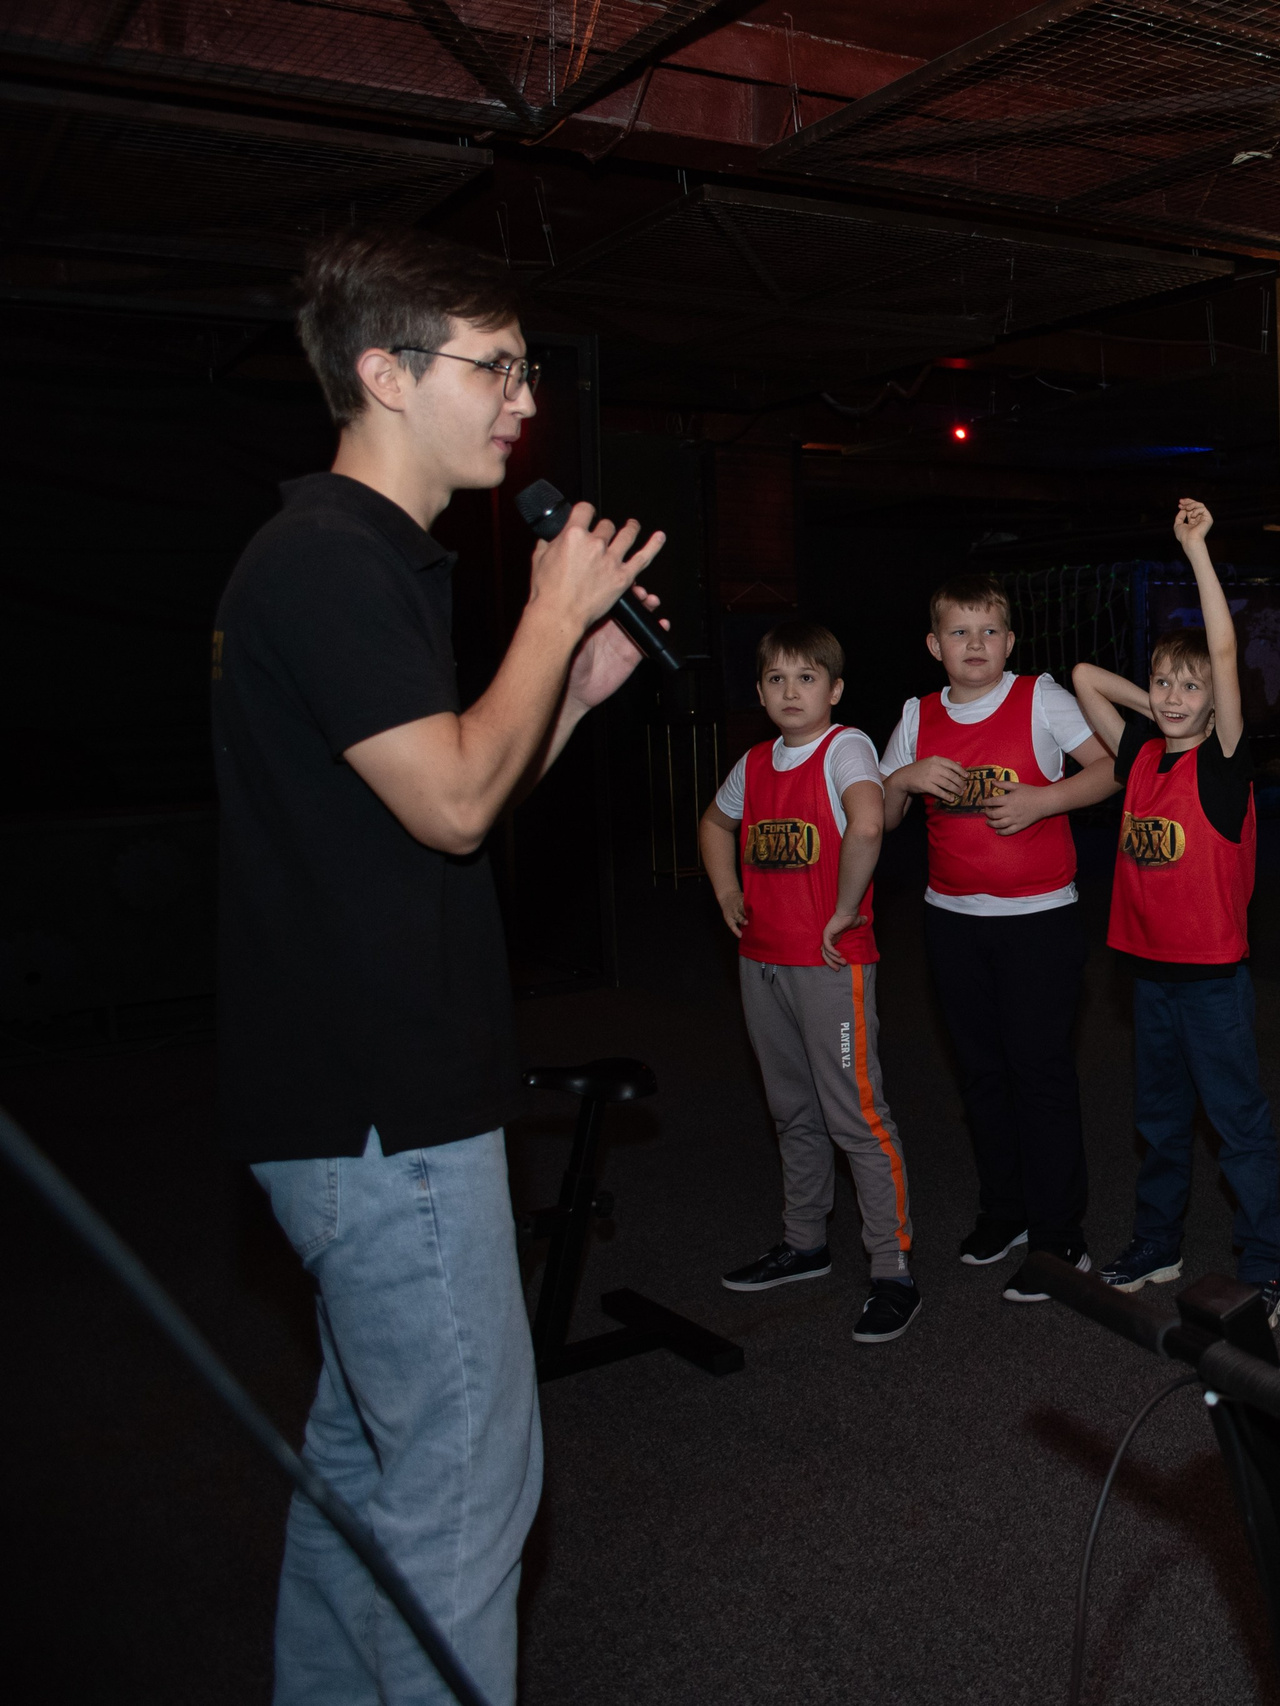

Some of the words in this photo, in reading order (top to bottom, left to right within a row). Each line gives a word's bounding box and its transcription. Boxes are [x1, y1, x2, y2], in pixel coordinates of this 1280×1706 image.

[763, 823, 793, 834] FORT
[840, 1022, 851, 1054] PLAYER
[841, 1054, 851, 1069] V.2
